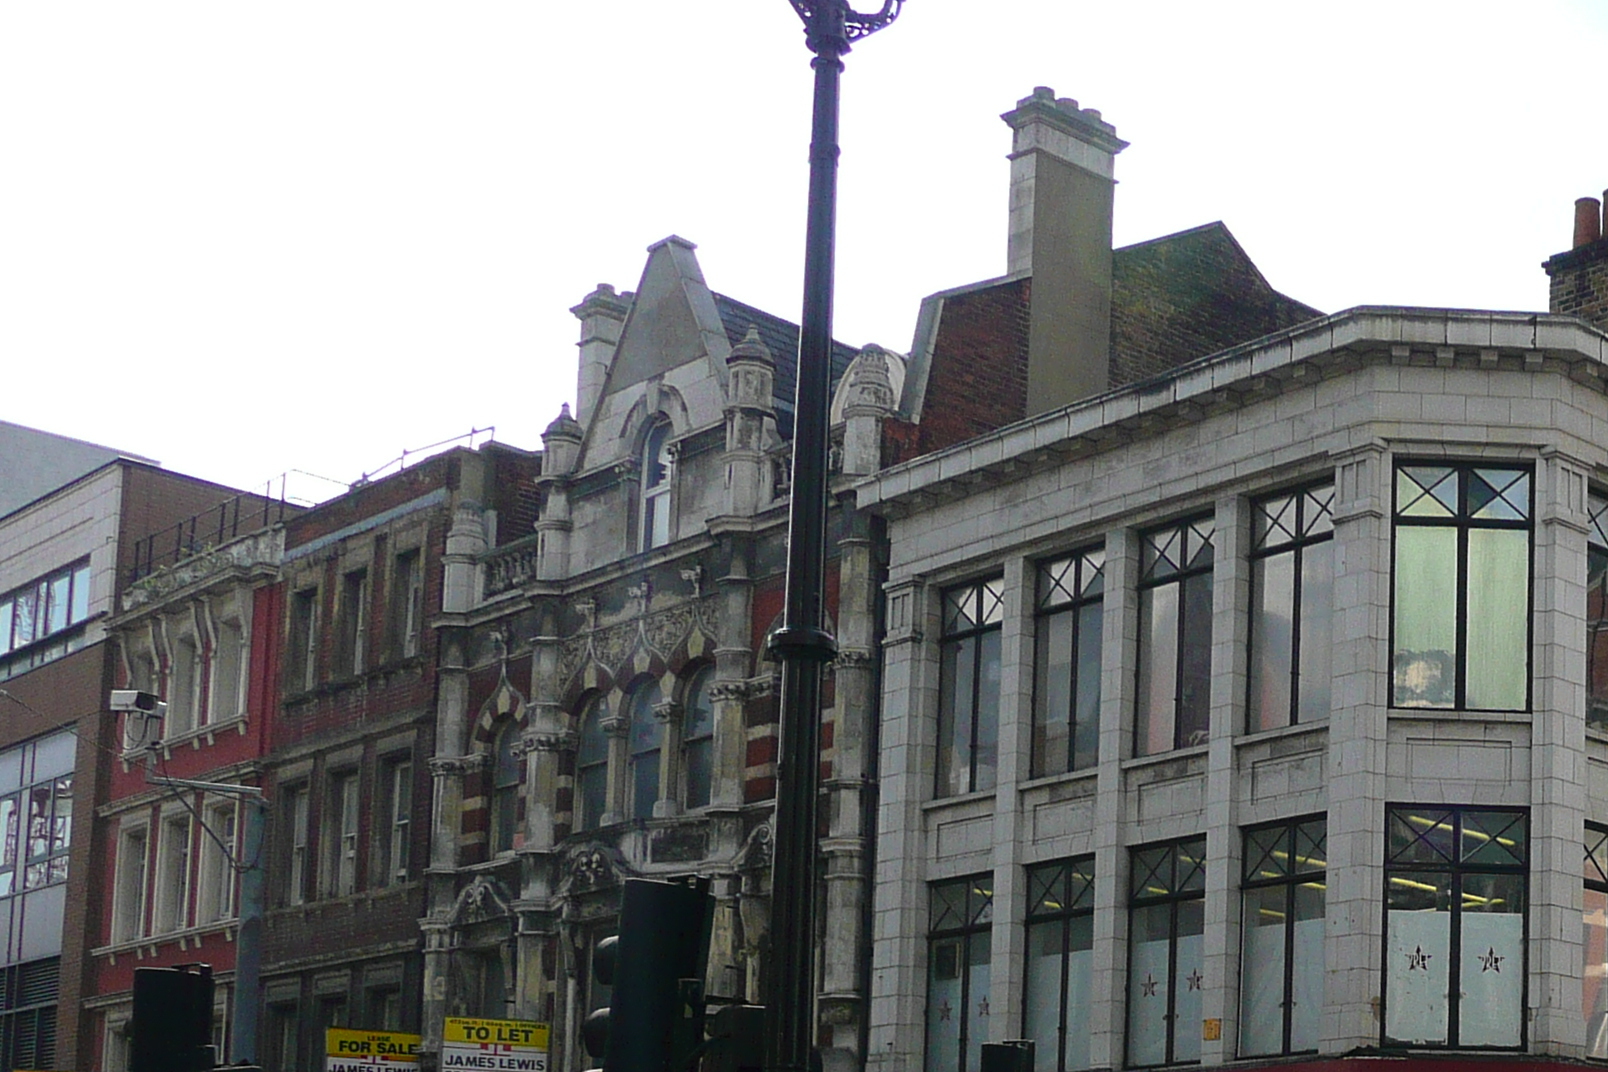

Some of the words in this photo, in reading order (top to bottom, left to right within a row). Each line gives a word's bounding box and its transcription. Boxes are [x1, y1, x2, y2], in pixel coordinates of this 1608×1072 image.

[463, 1026, 490, 1040] TO
[497, 1028, 534, 1042] LET
[339, 1040, 371, 1053] FOR
[376, 1042, 419, 1055] SALE
[445, 1055, 495, 1069] JAMES
[499, 1058, 545, 1071] LEWIS
